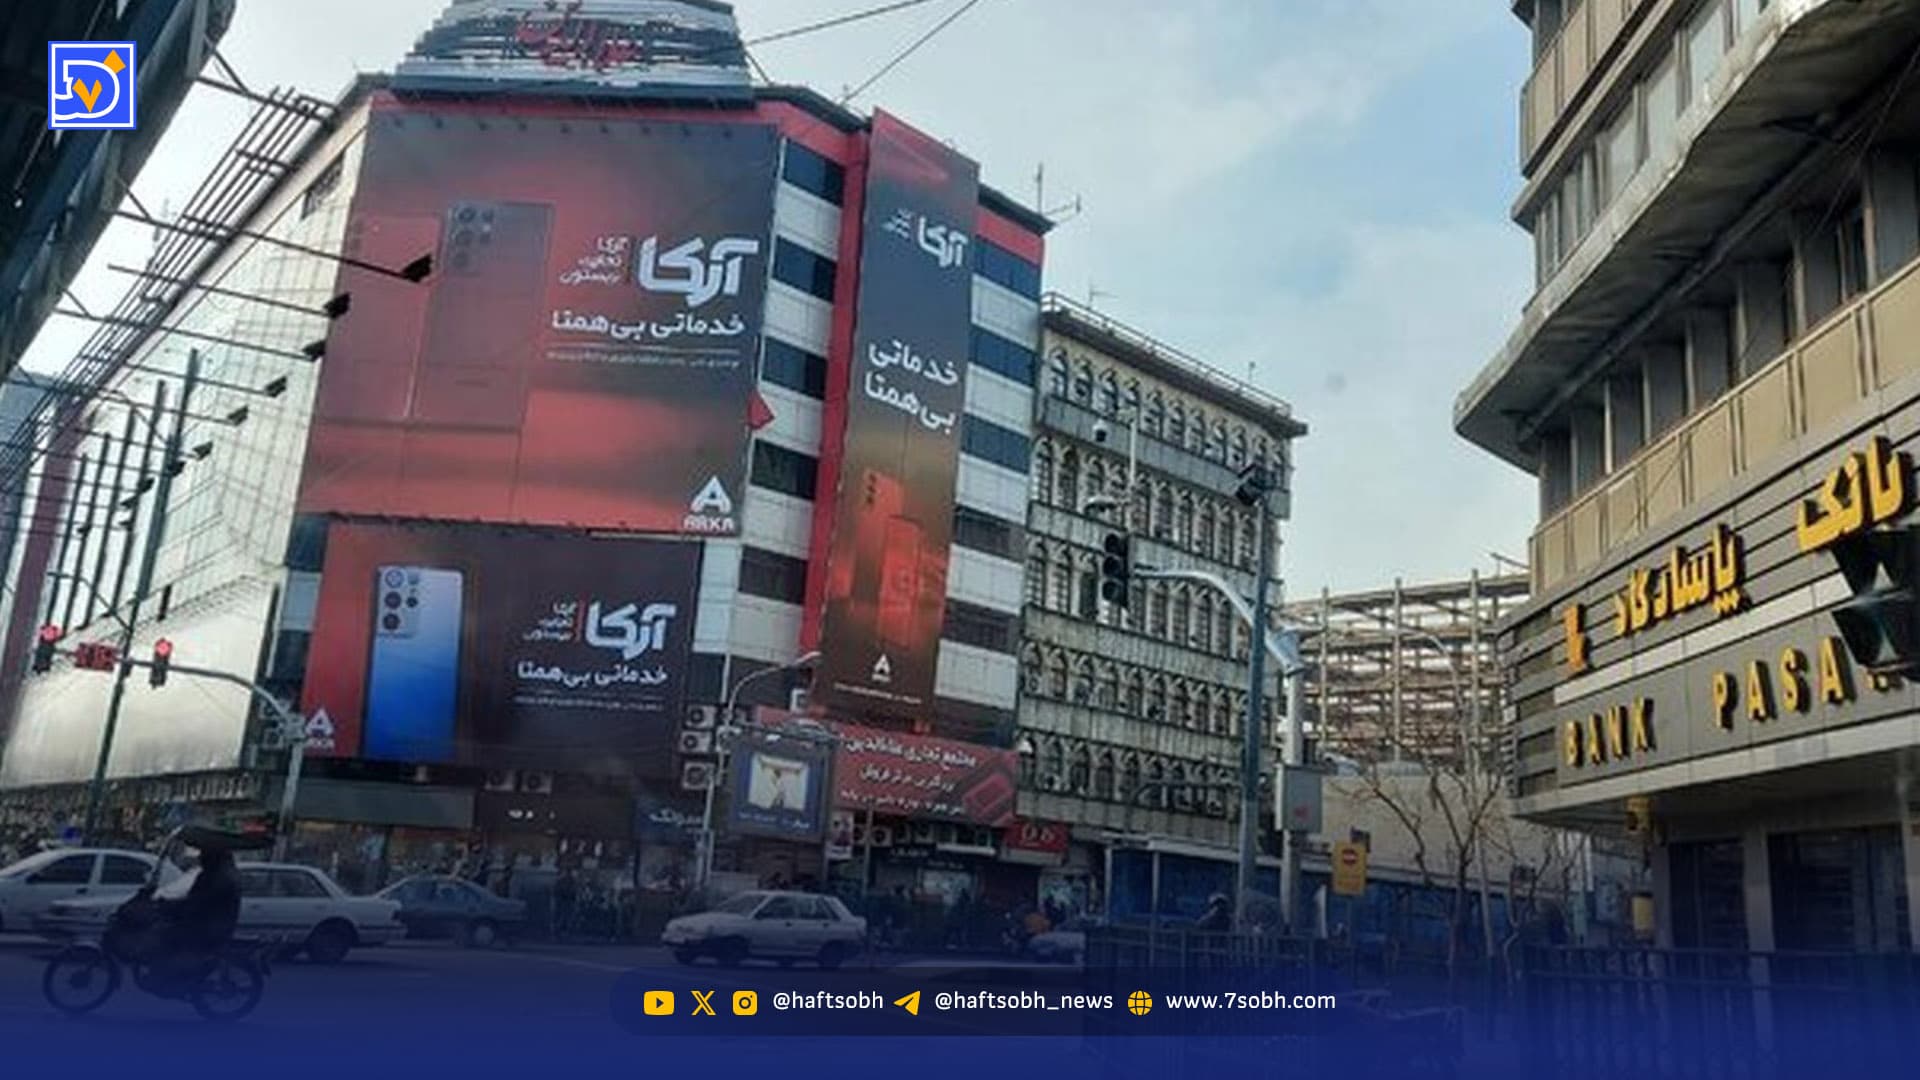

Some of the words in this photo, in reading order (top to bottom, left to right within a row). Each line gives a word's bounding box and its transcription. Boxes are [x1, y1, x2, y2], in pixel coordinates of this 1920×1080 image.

[638, 235, 759, 307] آرکا
[649, 312, 745, 337] خدماتی
[868, 339, 958, 386] خدماتی
[1796, 435, 1903, 551] بانک
[585, 601, 677, 660] آرکا
[594, 663, 669, 686] خدماتی
